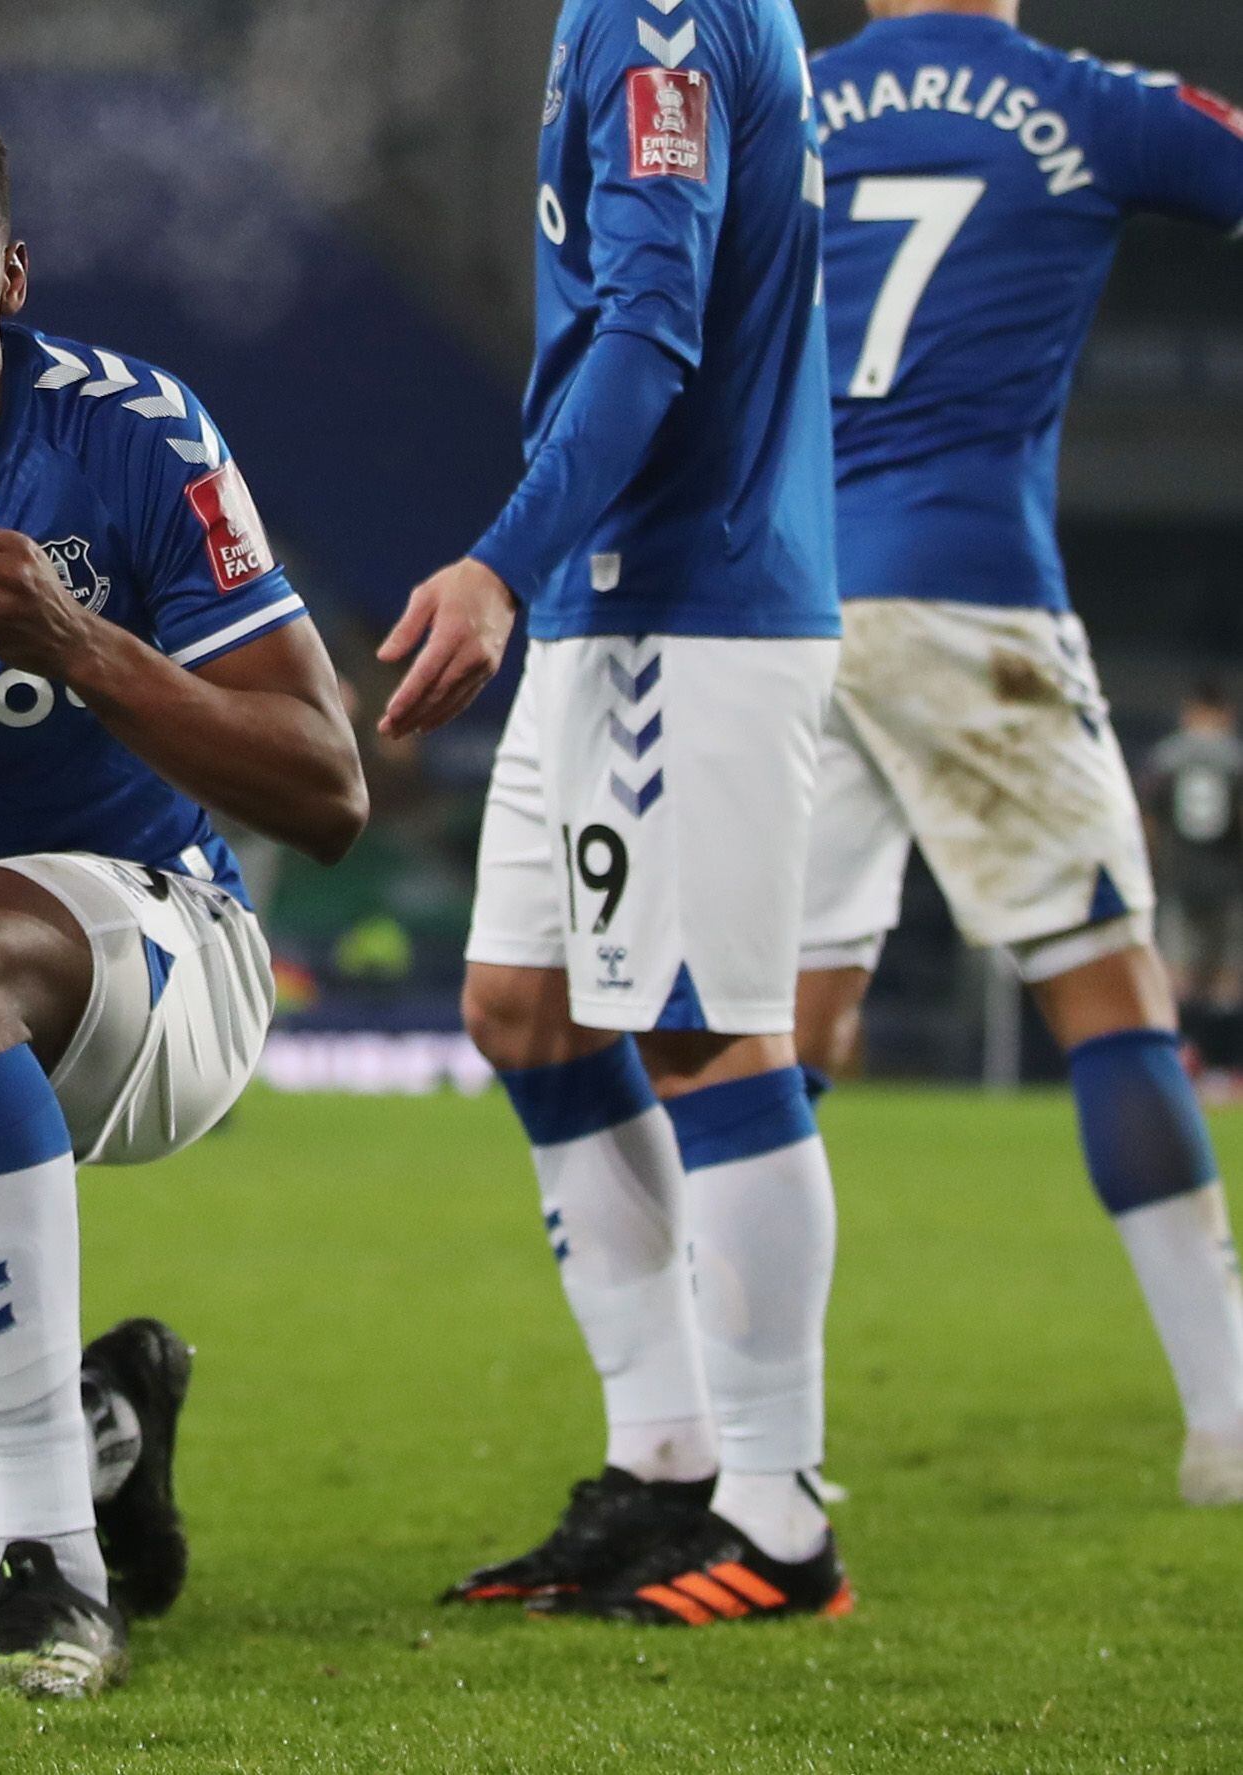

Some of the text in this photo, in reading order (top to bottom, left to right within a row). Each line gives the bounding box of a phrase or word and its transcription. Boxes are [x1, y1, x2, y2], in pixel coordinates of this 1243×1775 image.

[641, 134, 699, 153] Emirates
[641, 149, 699, 169] FA CUP
[847, 176, 988, 400] 7
[561, 823, 629, 935] 19
